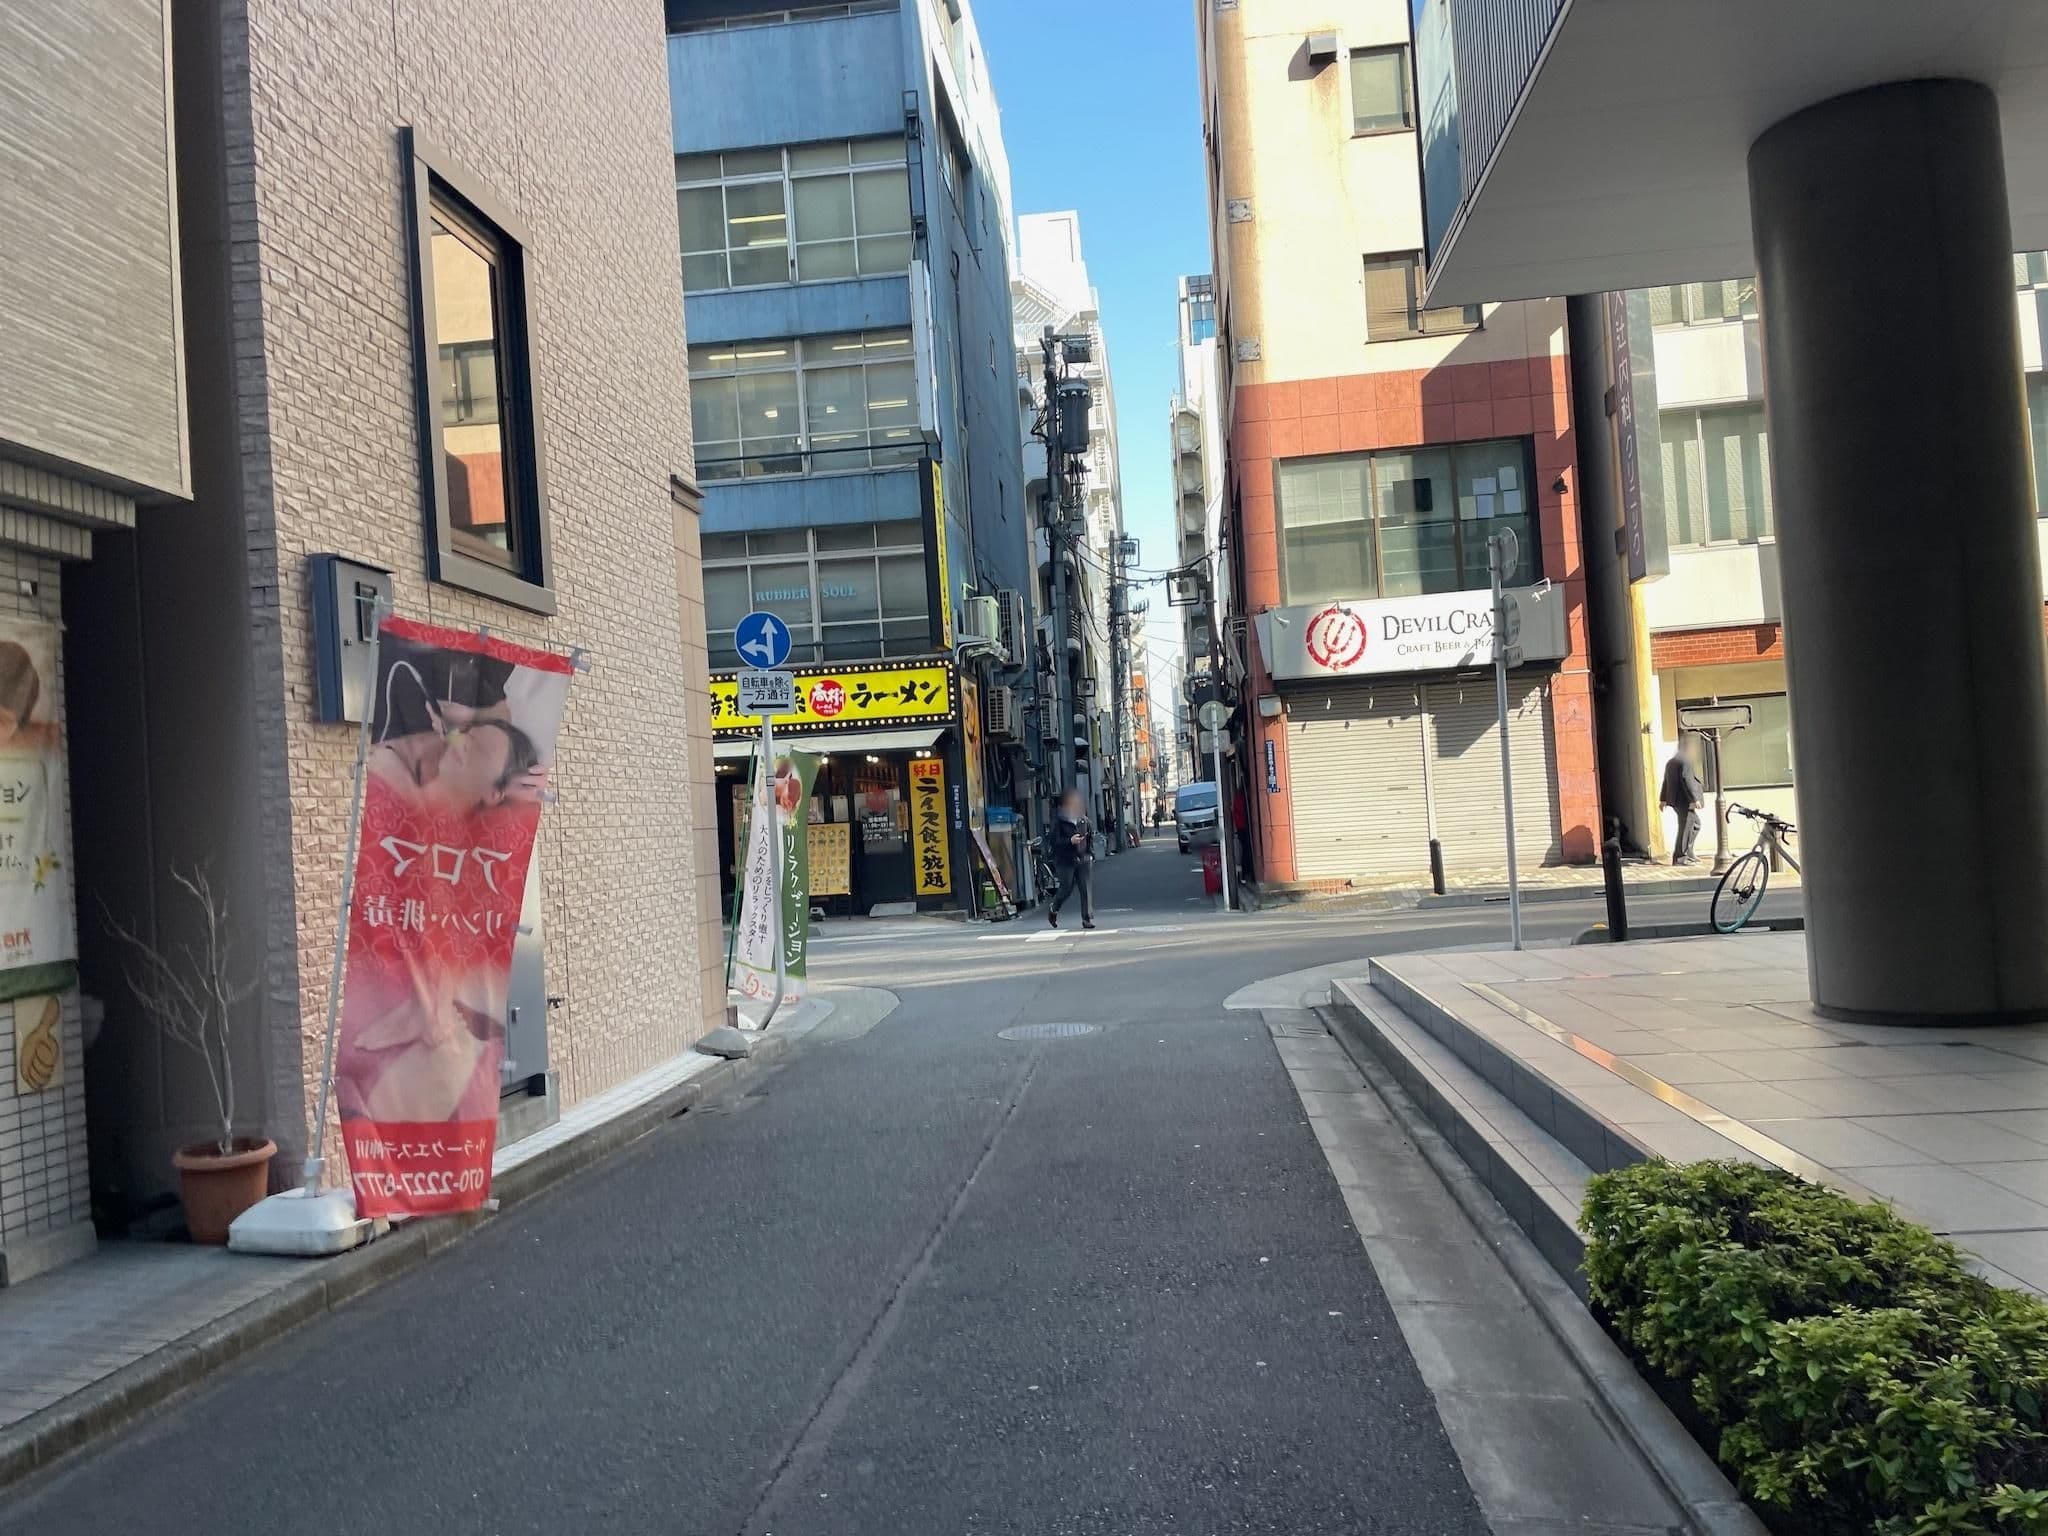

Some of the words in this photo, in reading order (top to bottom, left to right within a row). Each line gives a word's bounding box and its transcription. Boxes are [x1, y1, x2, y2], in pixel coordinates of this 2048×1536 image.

[821, 583, 856, 598] SOUL
[1381, 609, 1492, 641] DEVILCRA
[1397, 643, 1431, 655] CRAFT
[1435, 641, 1461, 653] BEER
[743, 676, 789, 689] 自転車を除く
[743, 689, 789, 701] 一方通行
[850, 680, 942, 708] ラーメン
[915, 777, 947, 888] ライス食べ放題
